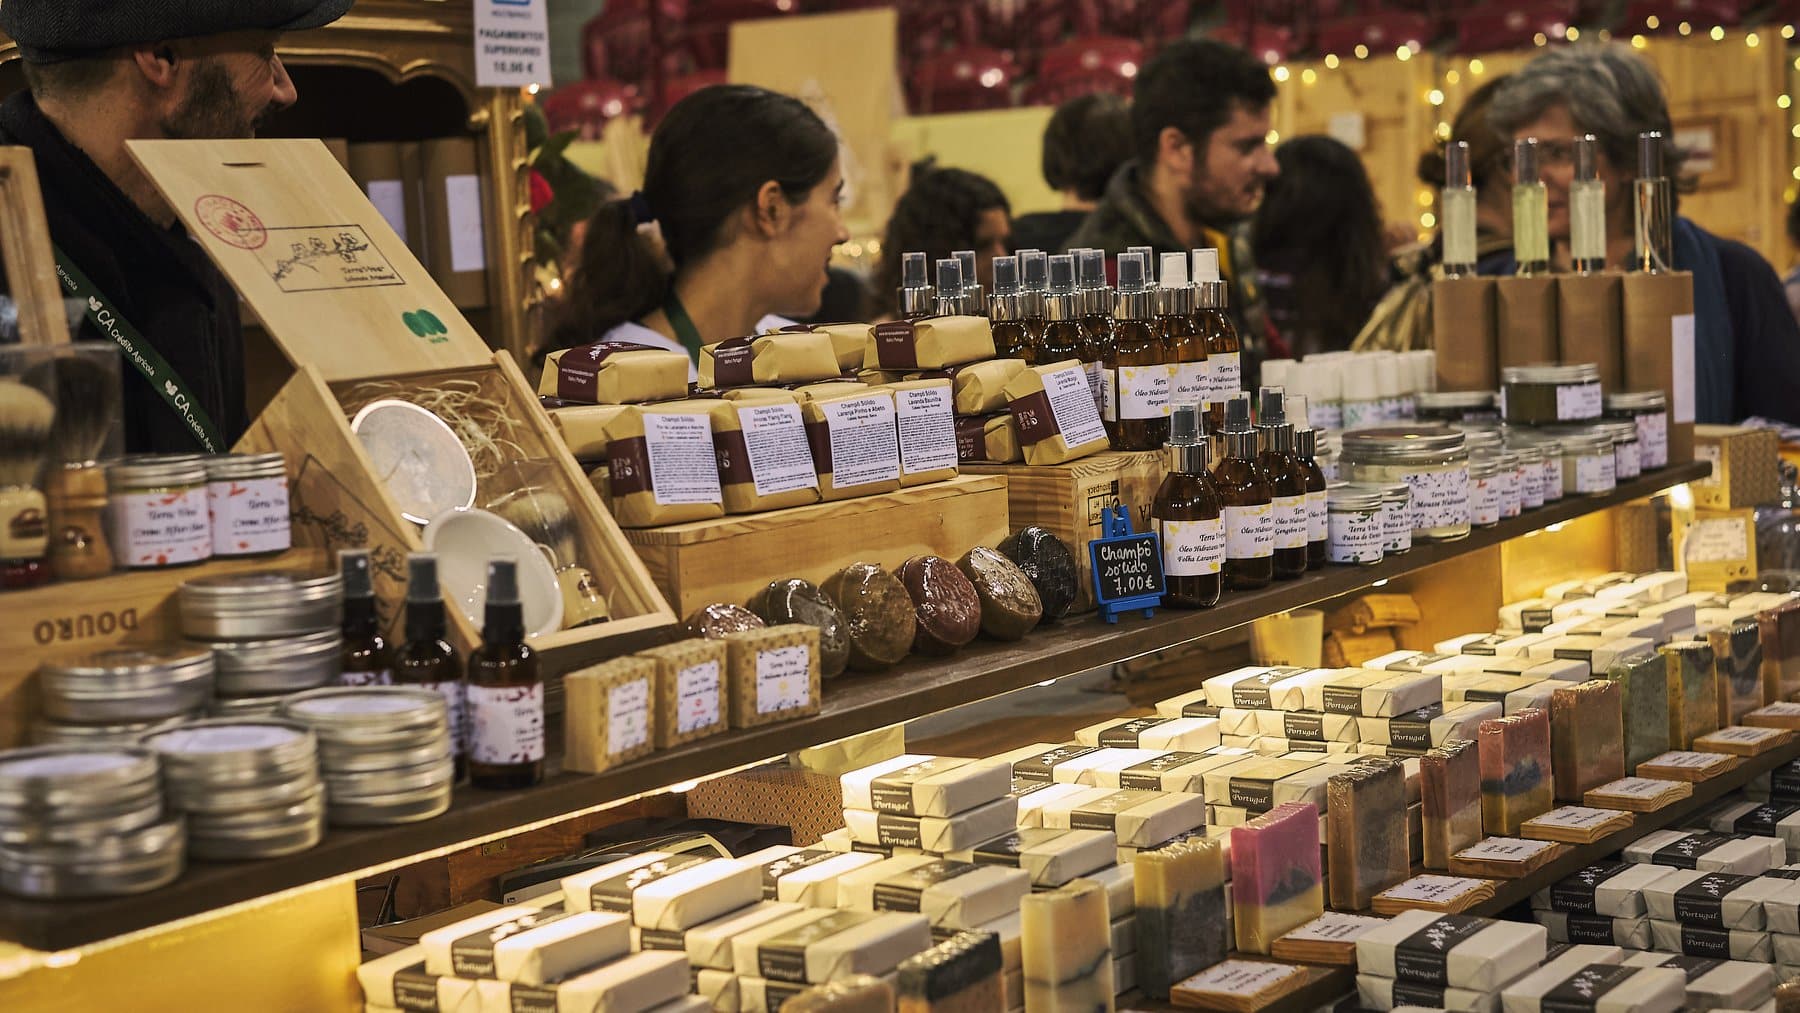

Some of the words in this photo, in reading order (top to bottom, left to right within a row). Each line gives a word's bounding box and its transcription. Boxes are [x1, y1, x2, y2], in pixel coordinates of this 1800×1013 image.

[97, 309, 116, 332] CA
[111, 328, 133, 354] Crédito
[174, 393, 190, 417] CA
[1348, 525, 1366, 534] Terra
[1200, 534, 1215, 543] Terra
[1342, 533, 1360, 541] Pasta
[1101, 540, 1152, 568] Champô
[1179, 544, 1193, 554] Óleo
[1105, 561, 1148, 577] sólido
[33, 608, 138, 645] DOURO
[1235, 694, 1267, 707] Portugal
[1325, 701, 1358, 712] Portugal
[1286, 726, 1319, 738] Portugal
[1392, 732, 1426, 744] Portugal
[1231, 792, 1268, 805] Portugal
[874, 800, 910, 813] Portugal
[882, 835, 919, 848] Portugal
[1556, 898, 1593, 911] Portugal
[1680, 908, 1718, 921] Portugal
[1572, 925, 1610, 939] Portugal
[1687, 937, 1726, 950] Portugal
[1400, 966, 1441, 980] Portugal
